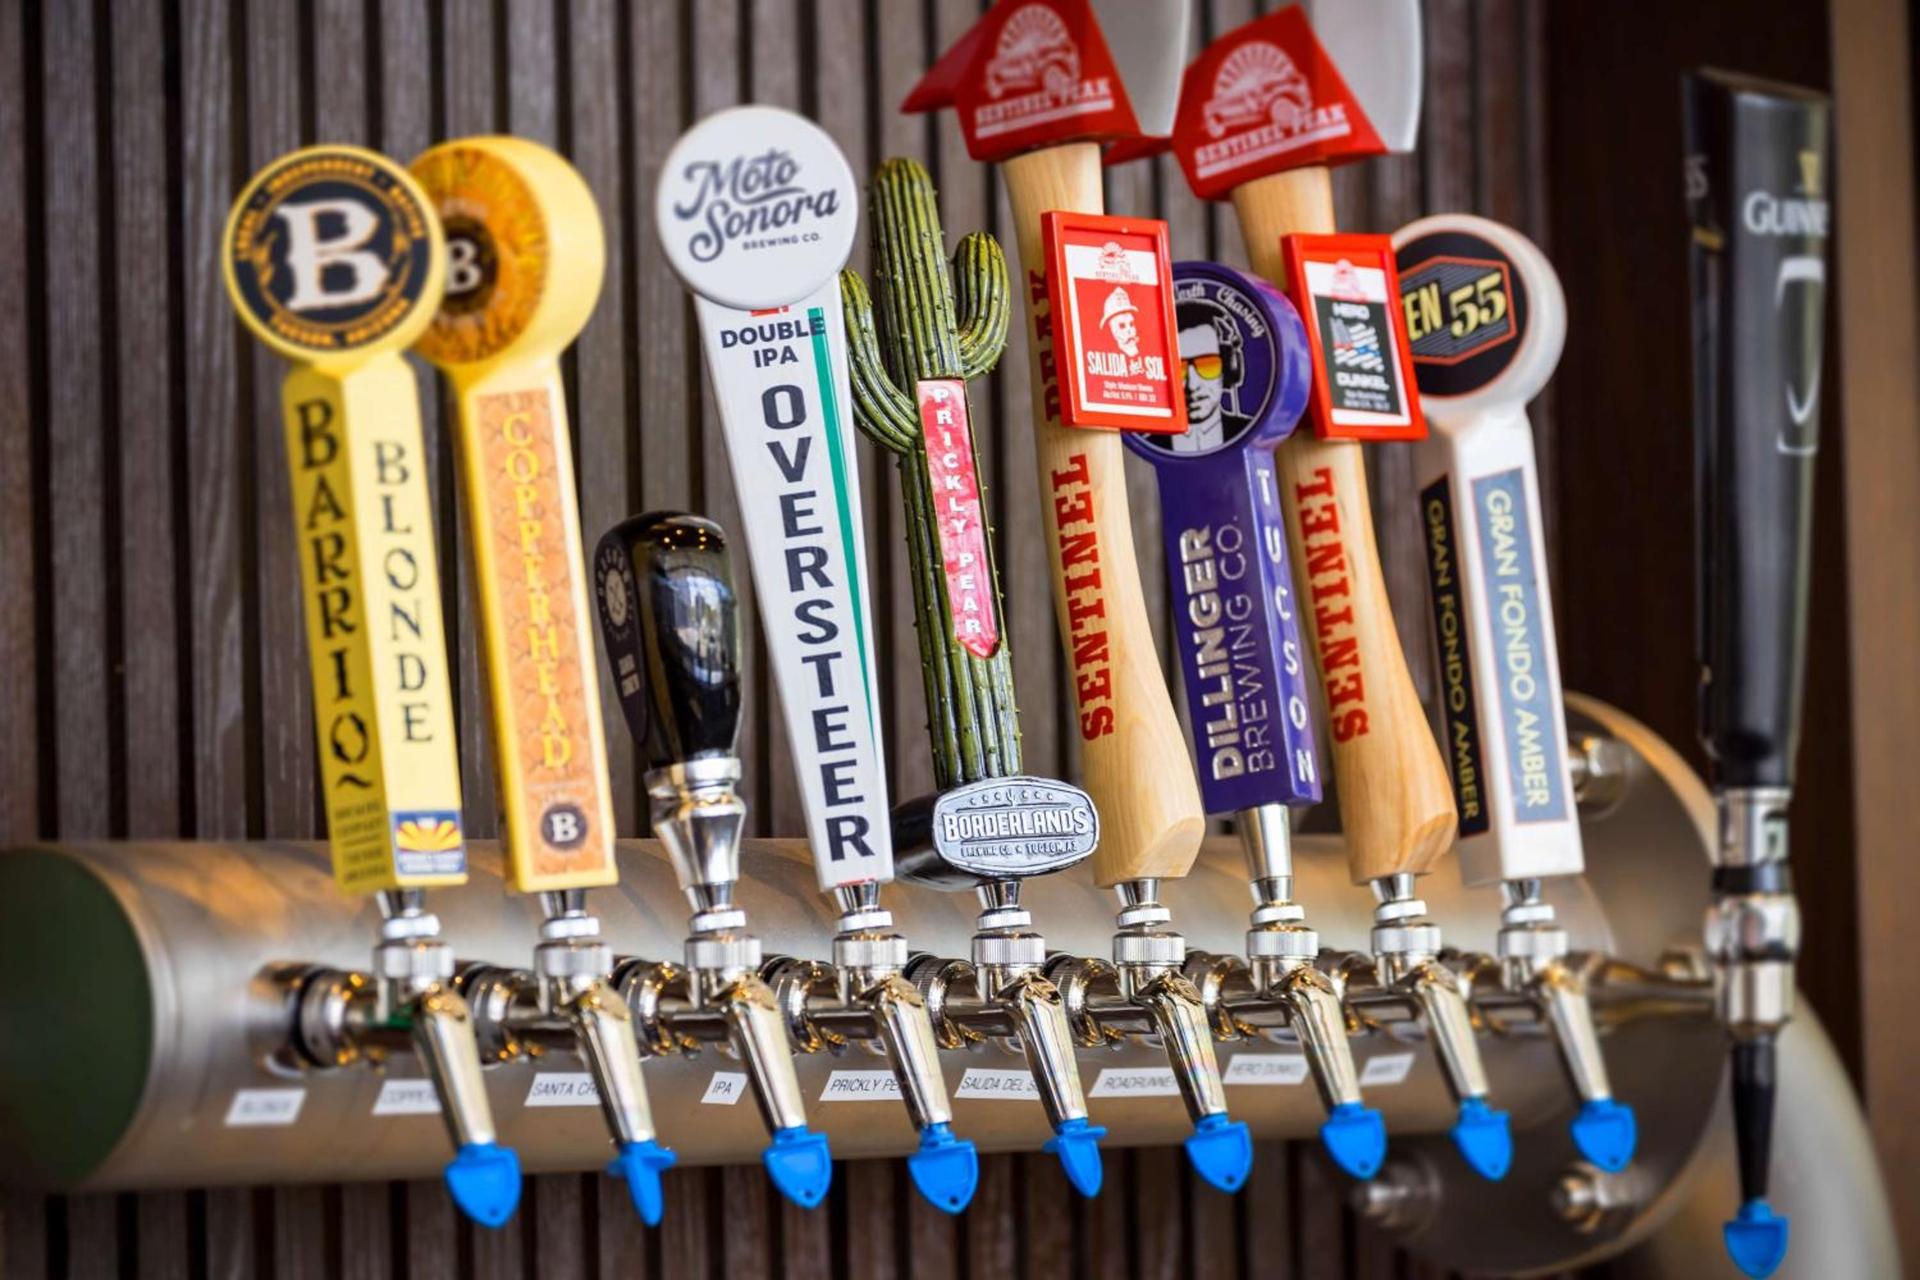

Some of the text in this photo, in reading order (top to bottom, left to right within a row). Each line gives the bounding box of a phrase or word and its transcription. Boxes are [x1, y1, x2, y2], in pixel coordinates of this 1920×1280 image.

[674, 149, 802, 220] Moto
[276, 199, 391, 310] B
[688, 188, 840, 263] Sonora
[743, 234, 799, 251] BREWING
[447, 238, 482, 294] B
[720, 317, 827, 349] DOUBLE
[1403, 271, 1507, 341] EN 55
[753, 345, 799, 368] IPA
[1087, 350, 1129, 378] SALIDA
[1145, 356, 1168, 381] SOL
[933, 388, 982, 635] PRICKLY PEAR
[295, 397, 371, 764] BARRIO
[374, 441, 433, 743] BLONDE
[503, 412, 571, 769] COPPERHEAD
[1051, 453, 1115, 742] SENTINEL
[1295, 467, 1369, 744] SENTINEL
[761, 384, 875, 862] OVERSTEER
[1179, 523, 1246, 782] DILLINGER
[1215, 515, 1276, 774] BREWING CO.
[1256, 467, 1316, 784] TUCSON
[1427, 499, 1480, 820] GRAN FONDO AMBER
[1486, 489, 1550, 808] GRAN FONDO AMBER
[551, 812, 579, 842] B
[942, 806, 1090, 843] BORDERLANDS
[532, 1082, 574, 1096] SANTA
[712, 1080, 733, 1093] IPA
[830, 1078, 900, 1092] PRICKLY PE
[961, 1076, 1039, 1092] SALIDA DEL S
